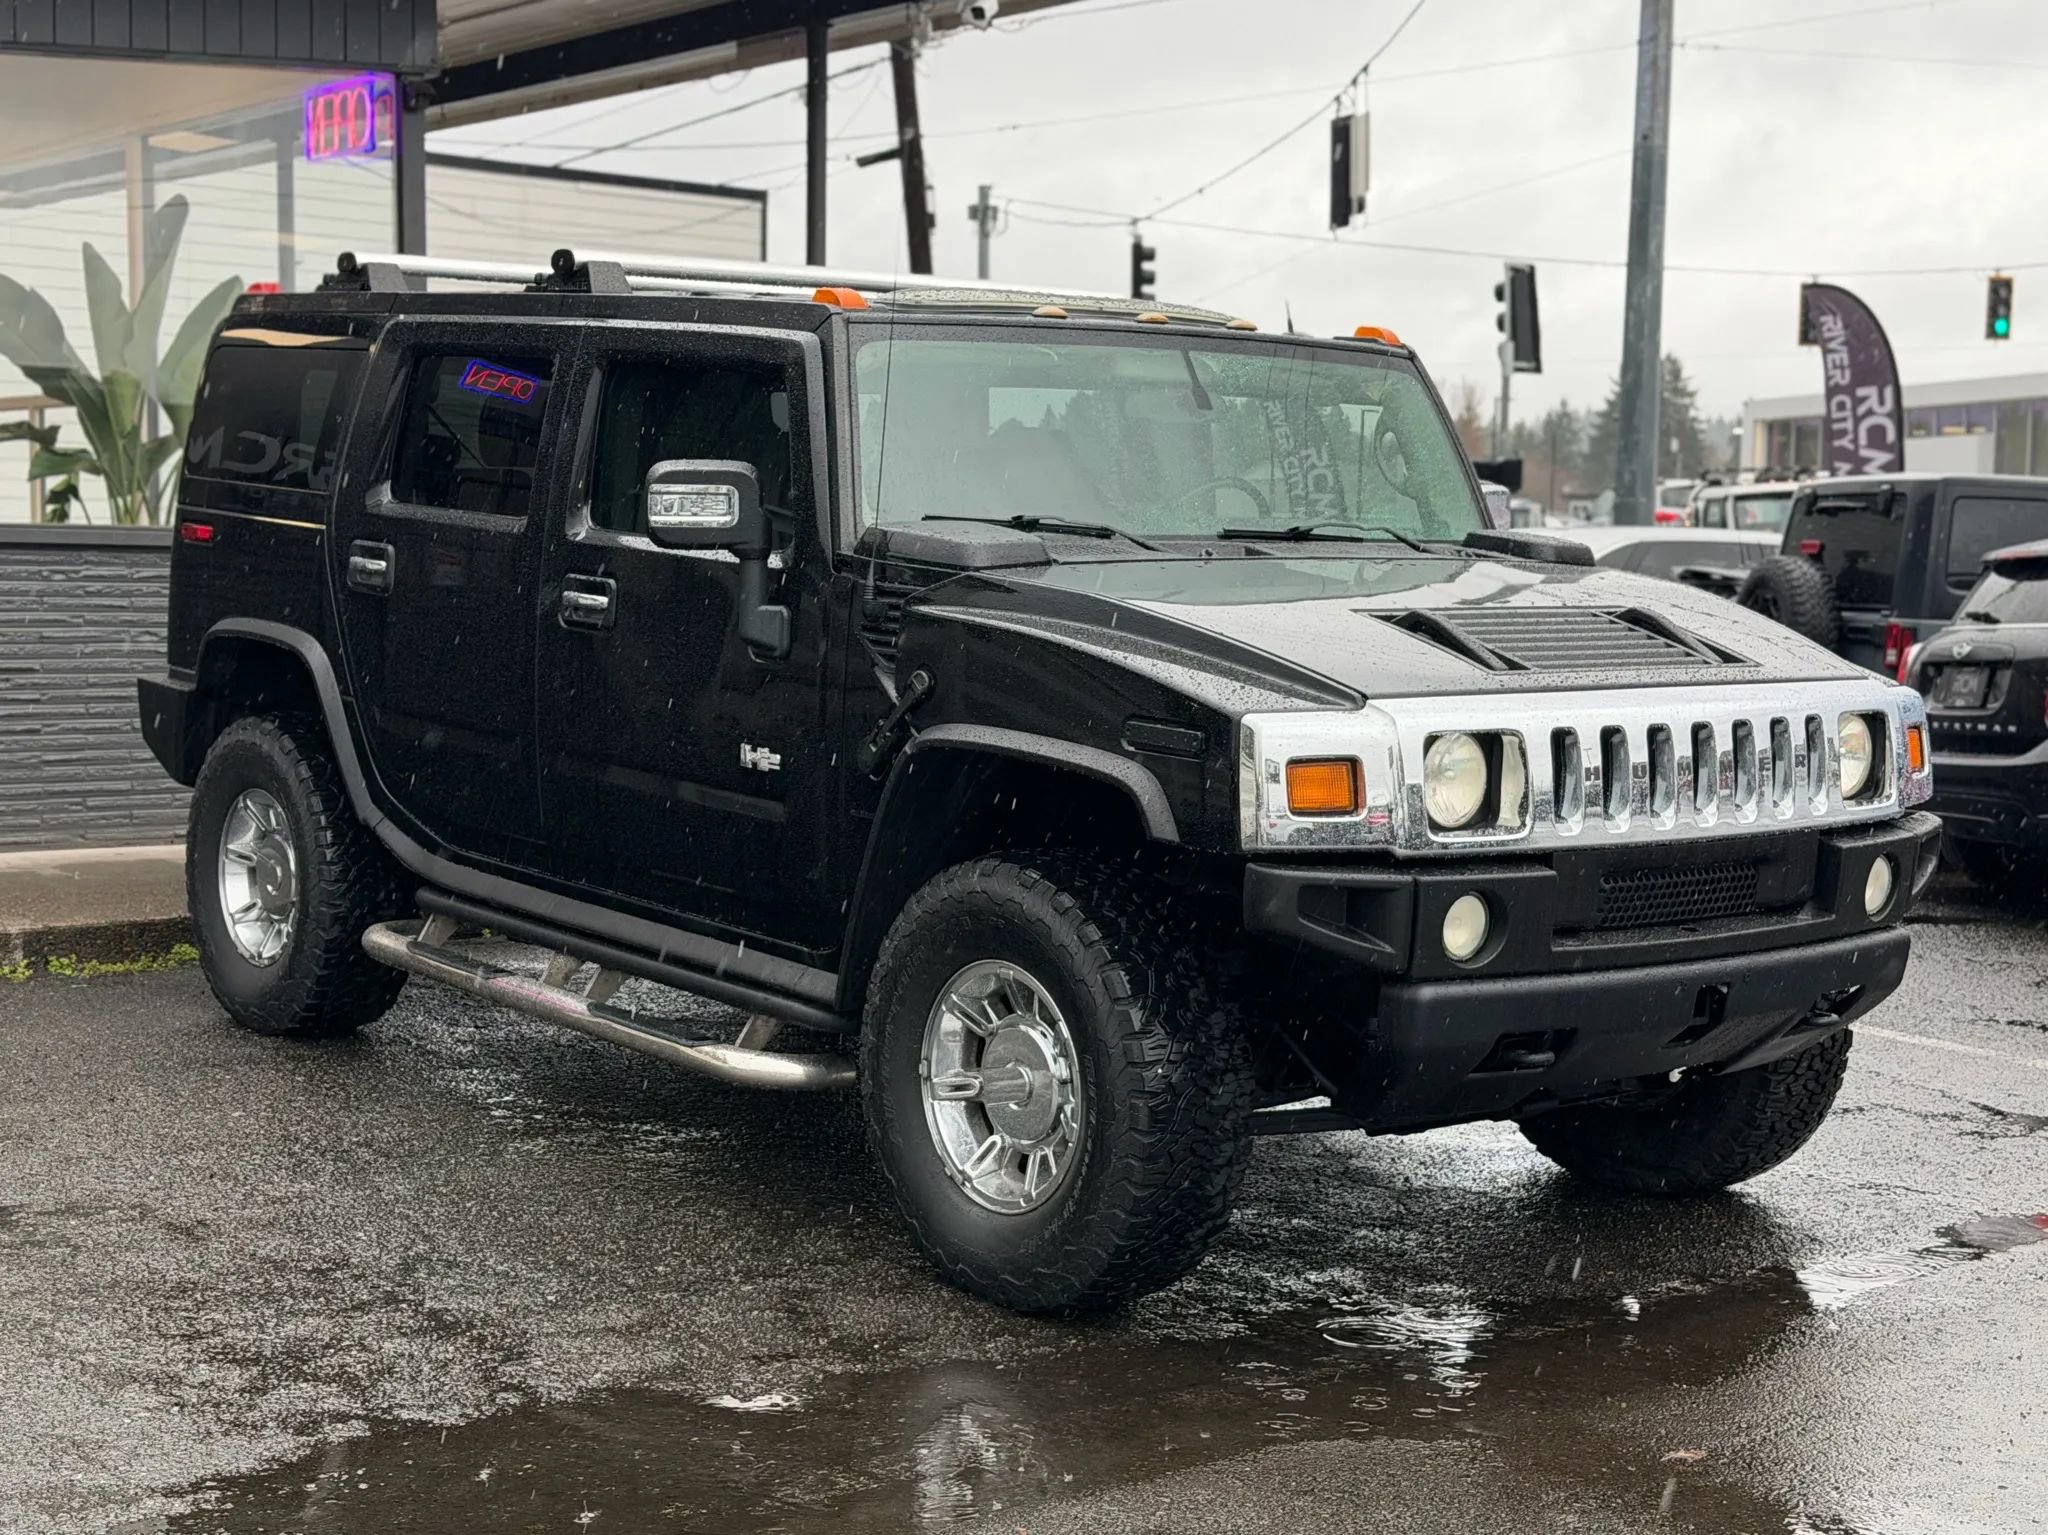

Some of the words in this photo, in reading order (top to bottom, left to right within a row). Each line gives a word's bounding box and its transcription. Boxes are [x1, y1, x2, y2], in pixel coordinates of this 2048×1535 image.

[1820, 313, 1851, 387] RIVER
[1829, 394, 1855, 451] CITY
[1584, 753, 1807, 782] HUMMER
